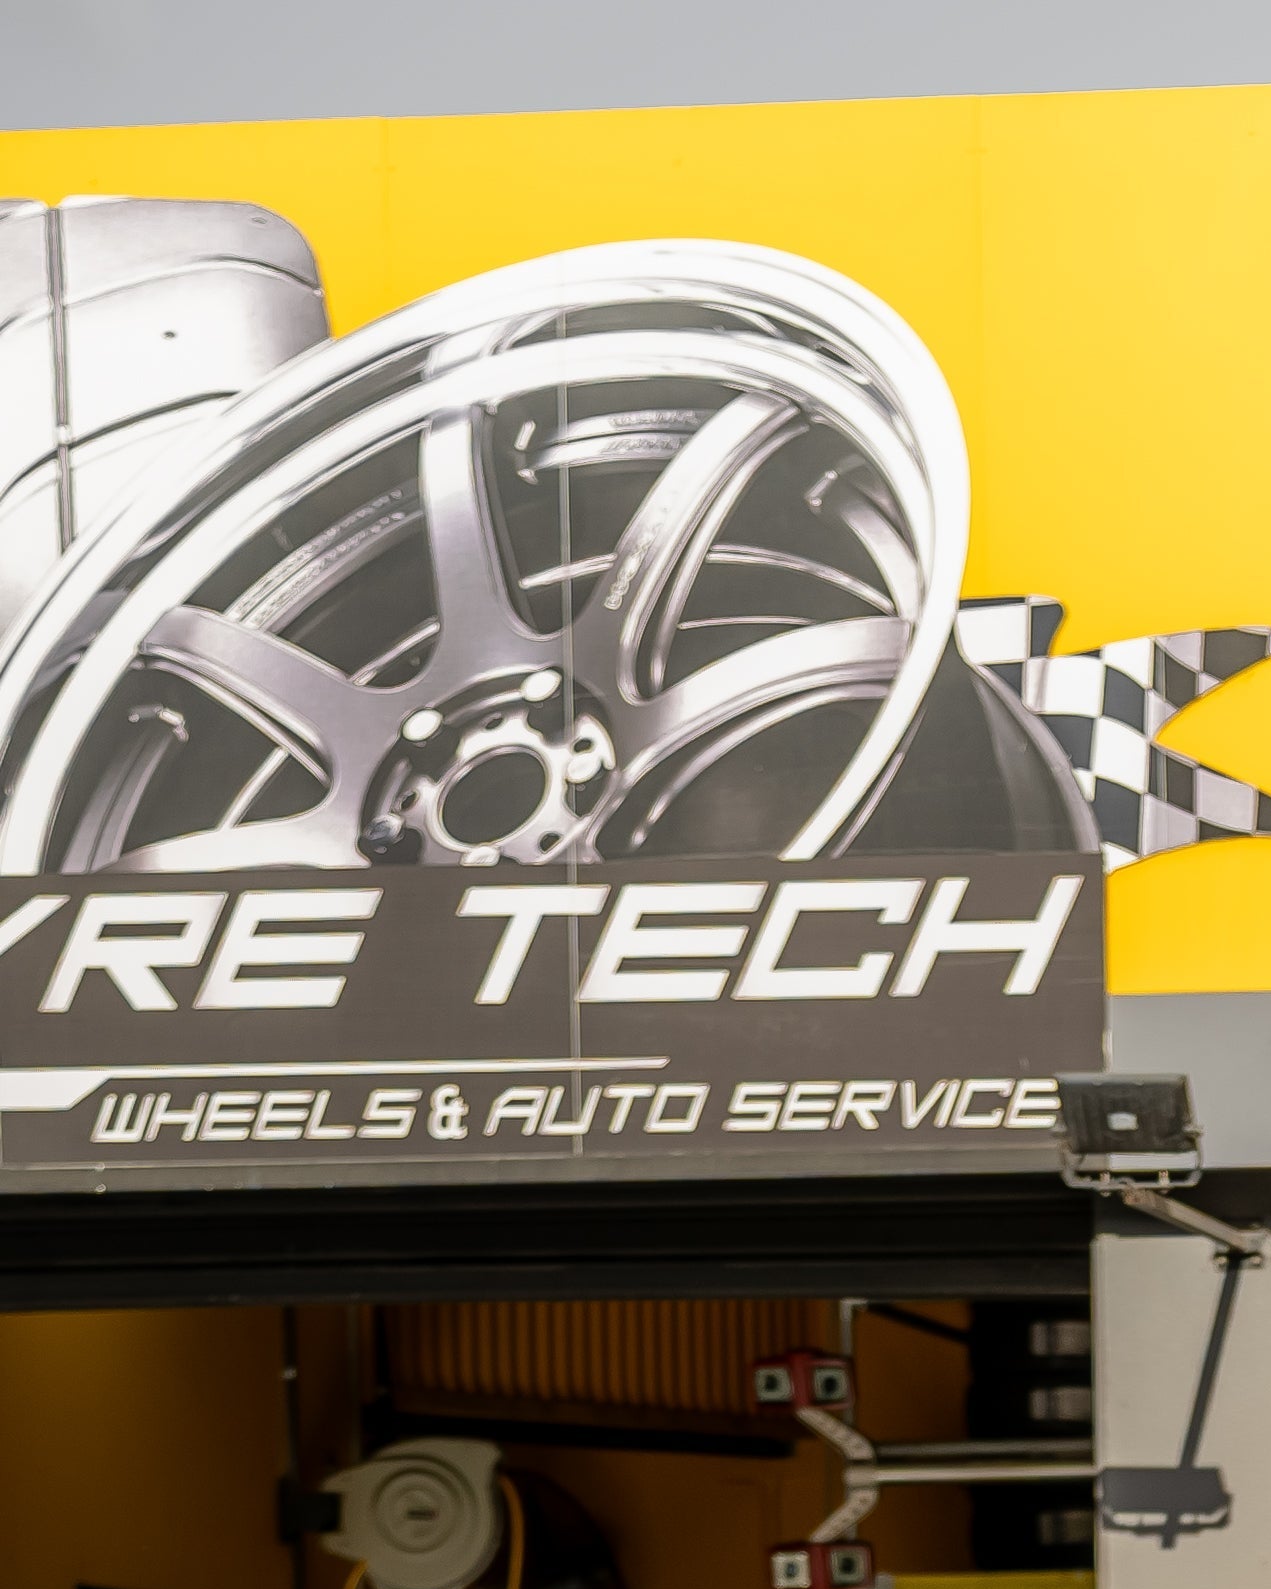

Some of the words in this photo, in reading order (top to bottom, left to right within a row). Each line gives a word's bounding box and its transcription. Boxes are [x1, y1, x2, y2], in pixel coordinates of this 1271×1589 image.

[456, 874, 1085, 1005] TECH
[482, 1082, 711, 1137] AUTO
[721, 1078, 1063, 1133] SERVICE
